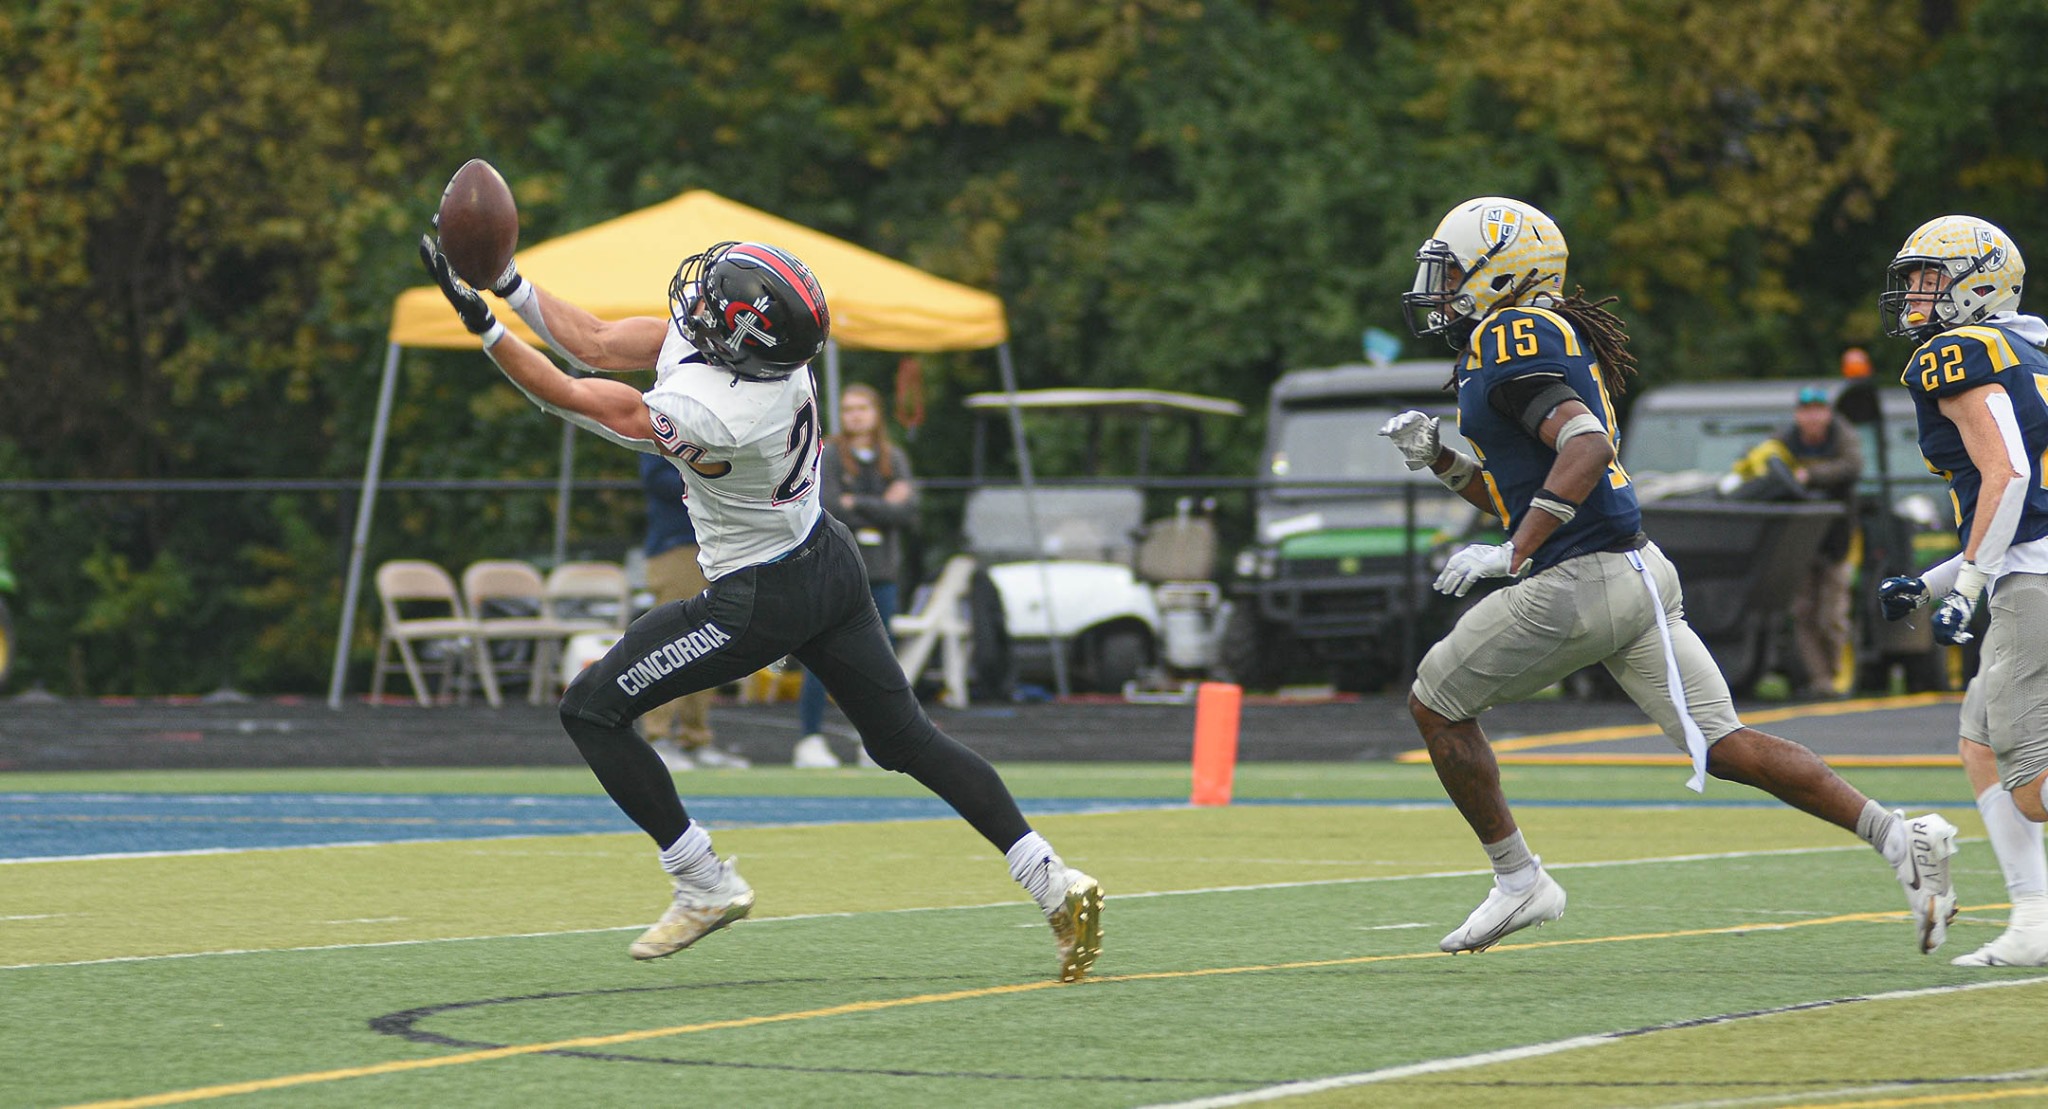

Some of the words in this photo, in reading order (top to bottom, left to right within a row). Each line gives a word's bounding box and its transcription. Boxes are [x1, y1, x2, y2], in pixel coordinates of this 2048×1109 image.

[1490, 317, 1539, 365] 15
[1919, 343, 1966, 392] 22
[771, 397, 824, 507] 2
[616, 622, 732, 696] CONCORDIA
